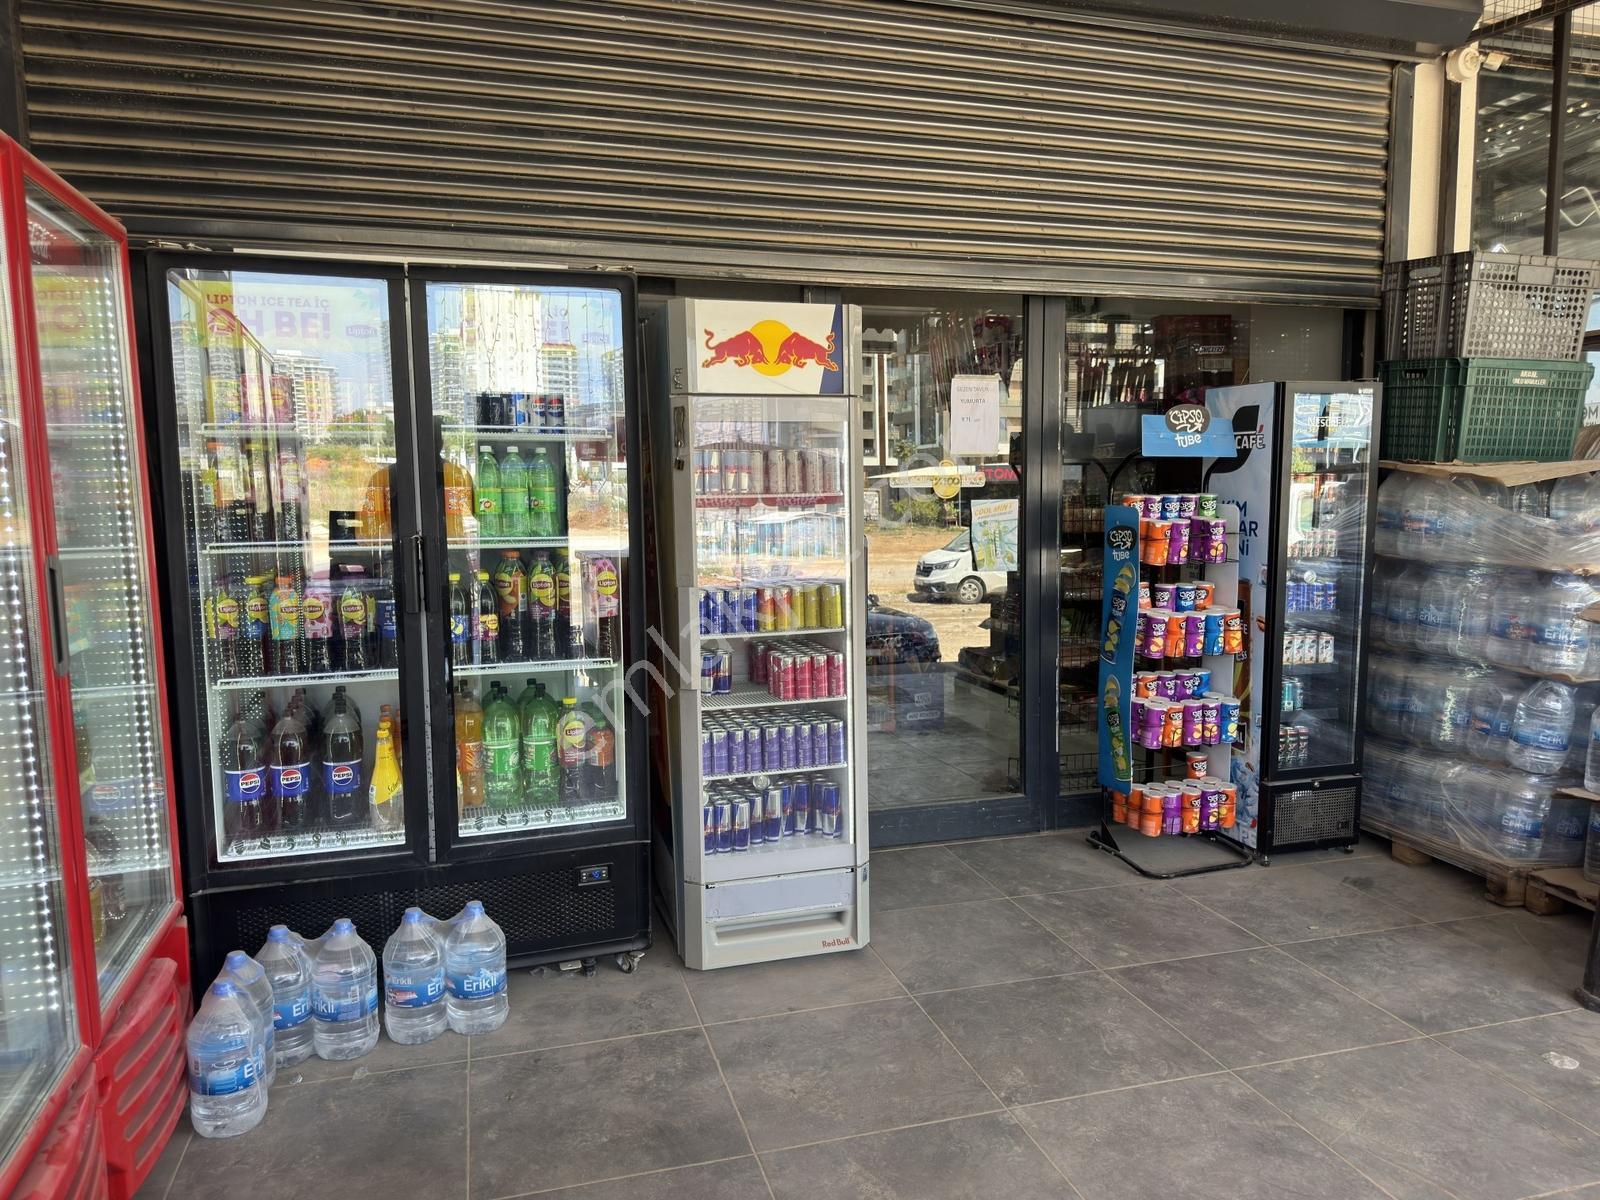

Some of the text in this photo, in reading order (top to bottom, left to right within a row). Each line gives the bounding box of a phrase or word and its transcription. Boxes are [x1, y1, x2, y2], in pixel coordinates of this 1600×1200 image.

[1240, 520, 1258, 537] AR
[532, 581, 551, 589] Lipton
[598, 580, 616, 588] Lipton
[281, 775, 301, 784] PEPSI
[332, 772, 353, 780] PEPSI
[240, 779, 260, 788] PEPSI
[822, 936, 850, 948] Red Bull
[464, 976, 496, 992] Erikli
